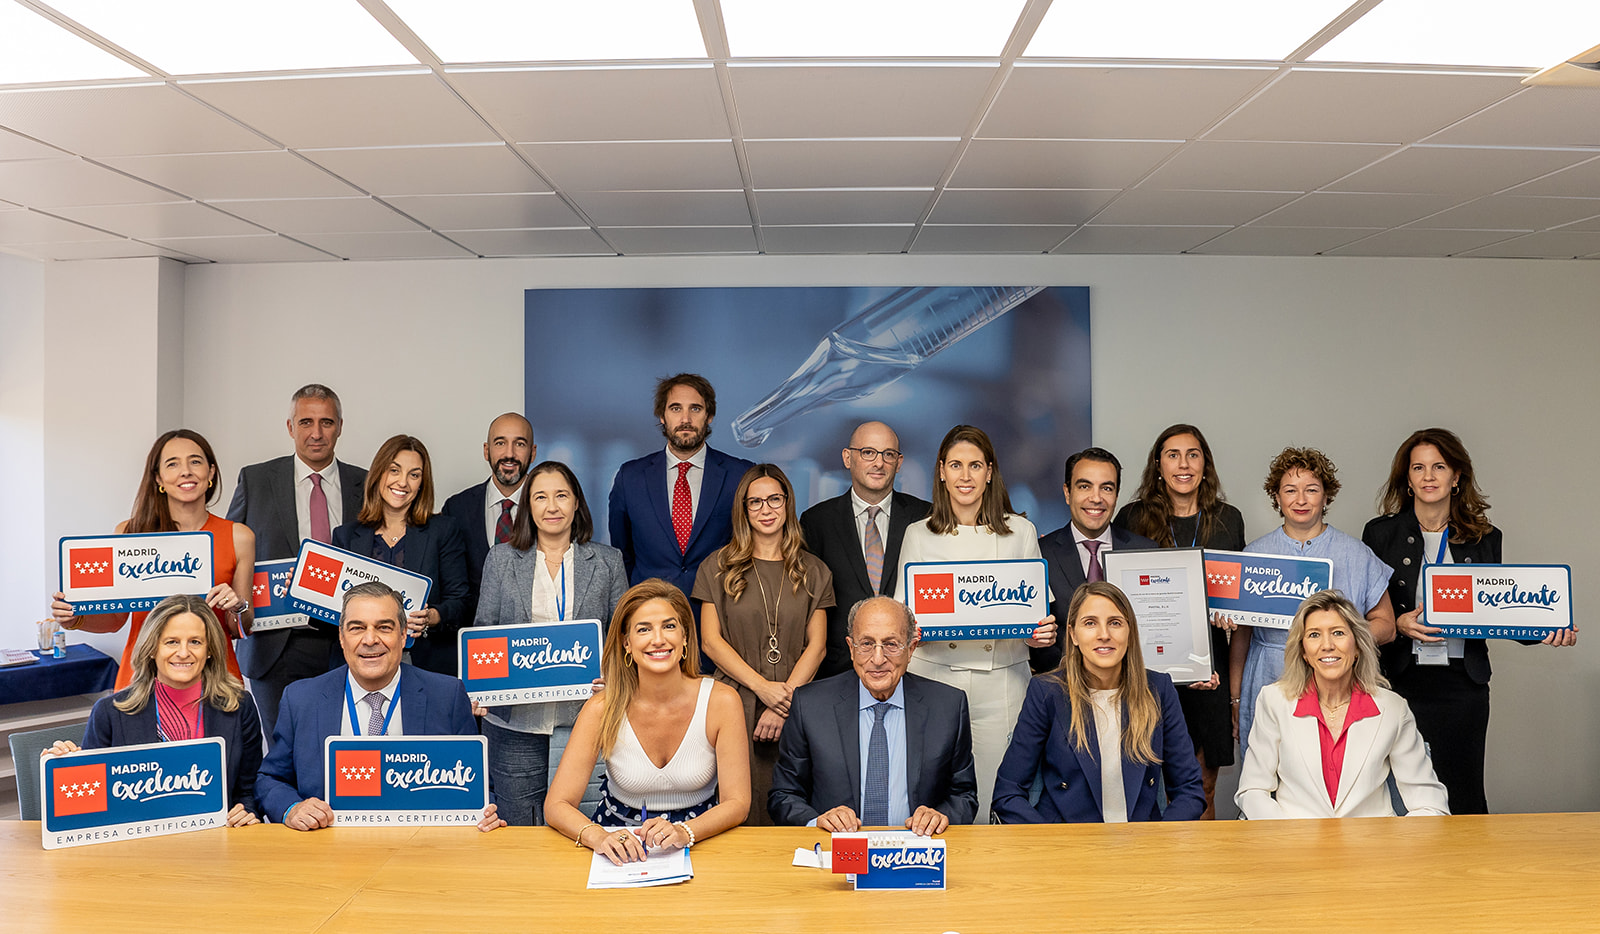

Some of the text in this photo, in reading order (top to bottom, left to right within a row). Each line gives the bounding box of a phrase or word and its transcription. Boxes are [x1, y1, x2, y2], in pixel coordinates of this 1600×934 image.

[118, 548, 158, 557] MADRID
[118, 553, 203, 579] excelente
[1244, 566, 1281, 576] MADRID
[345, 566, 380, 583] MADRID
[958, 575, 995, 584] MADRID
[1476, 578, 1515, 586] MADRID
[958, 580, 1038, 606] excelente
[1477, 584, 1561, 607] excelente
[71, 602, 124, 612] EMPRESA
[292, 600, 336, 621] EMPRESA
[1251, 617, 1291, 626] CERTIFI
[922, 627, 1033, 637] MPRESA CERTIFICAD
[511, 637, 550, 648] MADRID
[512, 641, 593, 670] excelente
[385, 753, 428, 763] MADRID
[111, 762, 160, 775] MADRID
[385, 760, 476, 789] excelente
[112, 764, 214, 800] excelente
[337, 814, 478, 823] EMPRESA CERTIFICADA
[56, 817, 215, 844] EMPRESA CERTIFICADA
[871, 846, 945, 869] excelente
